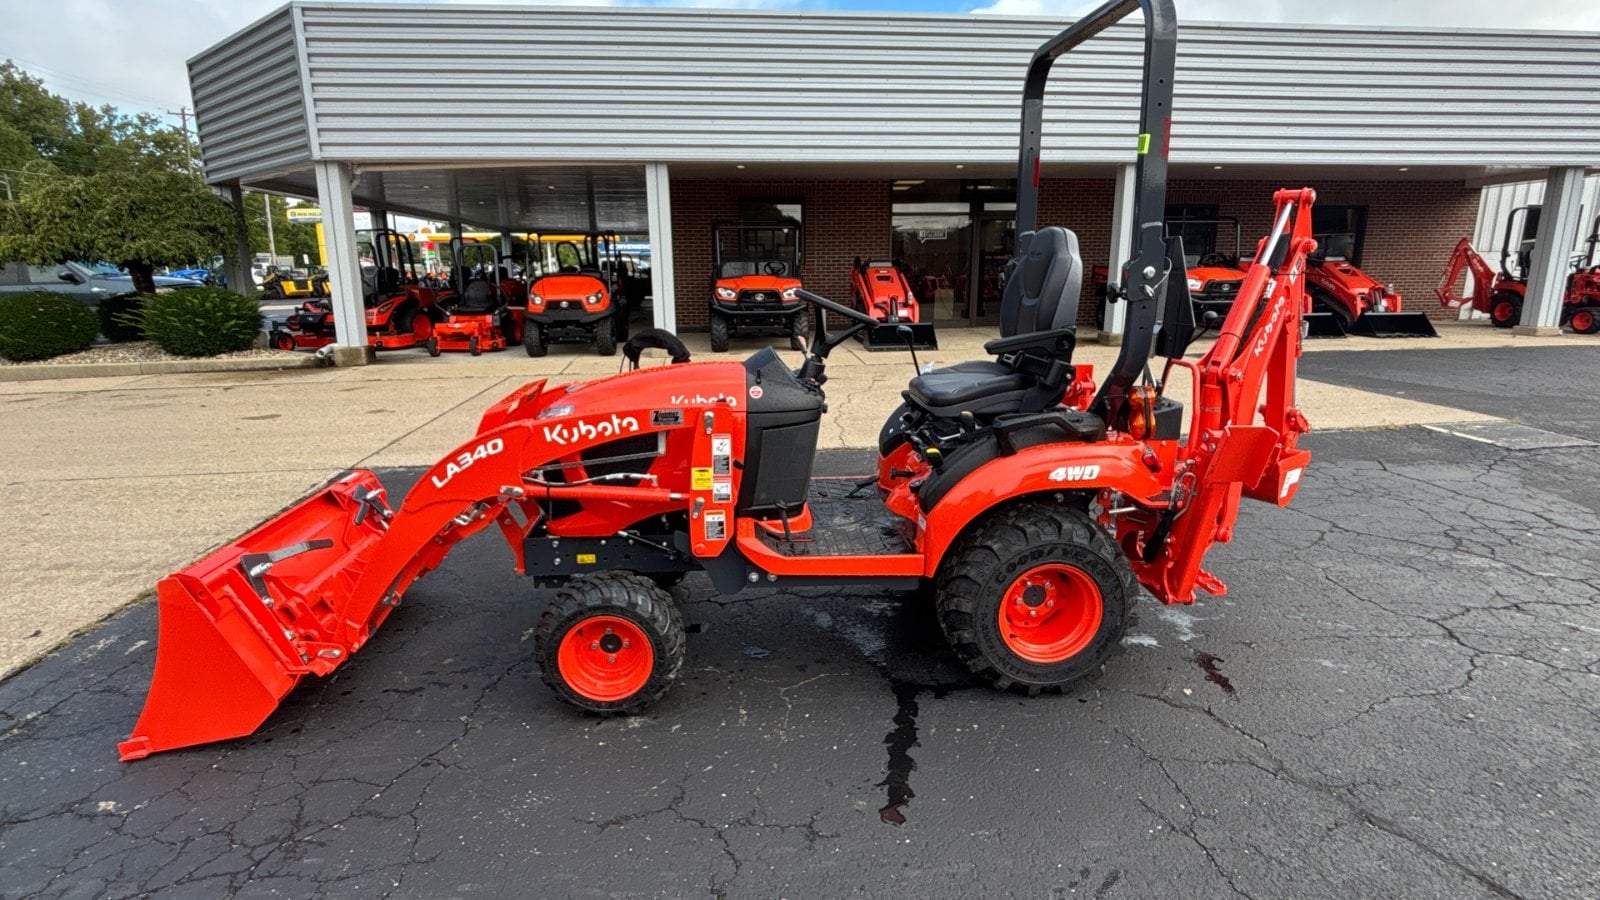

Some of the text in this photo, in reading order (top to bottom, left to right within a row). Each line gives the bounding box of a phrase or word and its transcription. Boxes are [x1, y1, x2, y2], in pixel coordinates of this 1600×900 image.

[1254, 295, 1285, 357] Kubota
[543, 413, 640, 445] Kubota
[431, 438, 504, 489] LA340
[1047, 464, 1100, 482] 4WD
